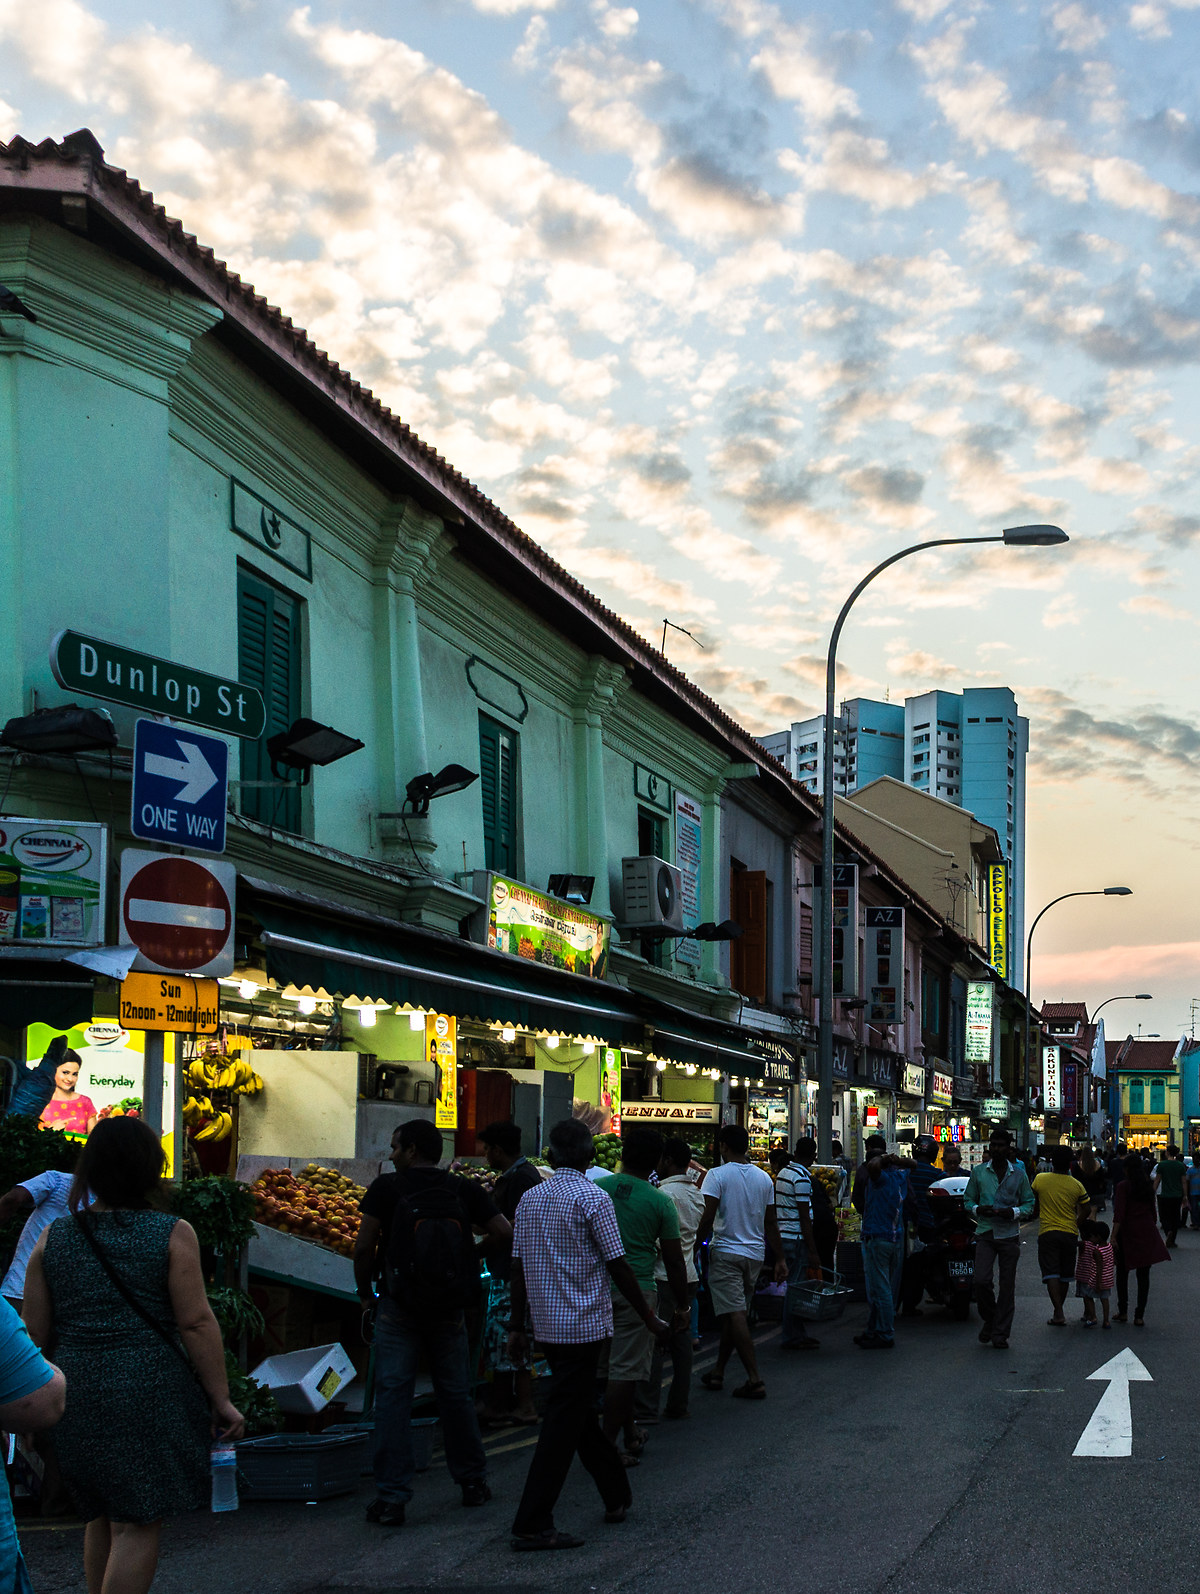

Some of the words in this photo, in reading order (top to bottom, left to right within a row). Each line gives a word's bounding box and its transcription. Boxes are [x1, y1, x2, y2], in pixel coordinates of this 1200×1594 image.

[80, 642, 200, 714] Dunlop
[218, 685, 247, 722] St
[141, 804, 178, 832] ONE
[186, 812, 218, 840] WAY
[20, 838, 72, 848] CHENNAI
[510, 886, 531, 905] CHENNAI
[992, 867, 1003, 913] APPOLLO
[874, 910, 894, 923] AZ
[160, 980, 180, 998] Sun
[122, 1001, 156, 1020] 12noon
[166, 1004, 216, 1028] 12midnight
[764, 1062, 769, 1077] &
[770, 1062, 791, 1080] TRAVEL
[90, 1074, 135, 1088] Everyday
